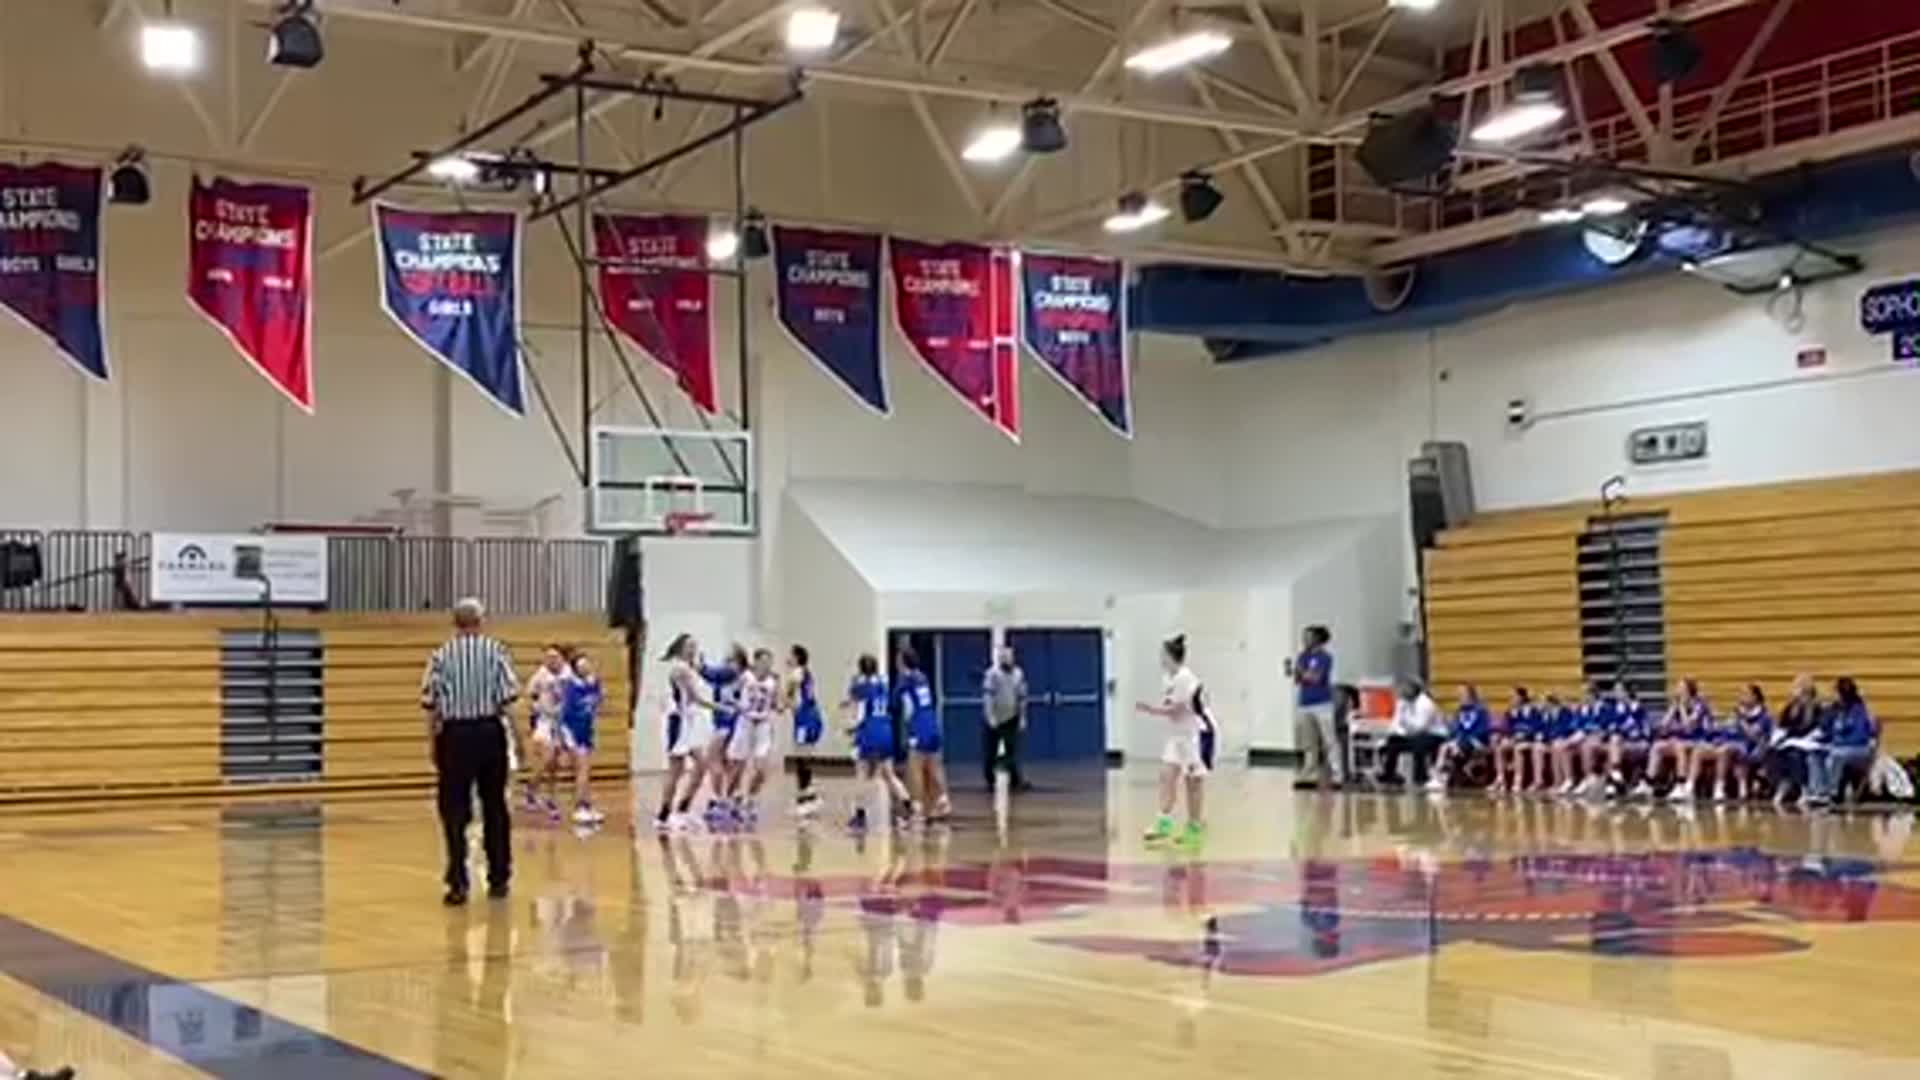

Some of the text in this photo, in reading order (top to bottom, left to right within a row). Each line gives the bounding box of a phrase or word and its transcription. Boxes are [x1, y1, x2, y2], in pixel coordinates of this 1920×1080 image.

[4, 187, 57, 207] STATE
[216, 199, 270, 223] STATE
[195, 220, 297, 248] CHAMPIONS
[418, 232, 474, 251] STATE
[627, 236, 677, 254] STATE
[394, 250, 501, 273] CHAMPIONS
[805, 250, 849, 267] STATE
[919, 259, 961, 275] STATE
[787, 264, 870, 288] CHAMPIONS
[1051, 275, 1091, 291] STATE
[1033, 290, 1111, 312] CHAMPIONS
